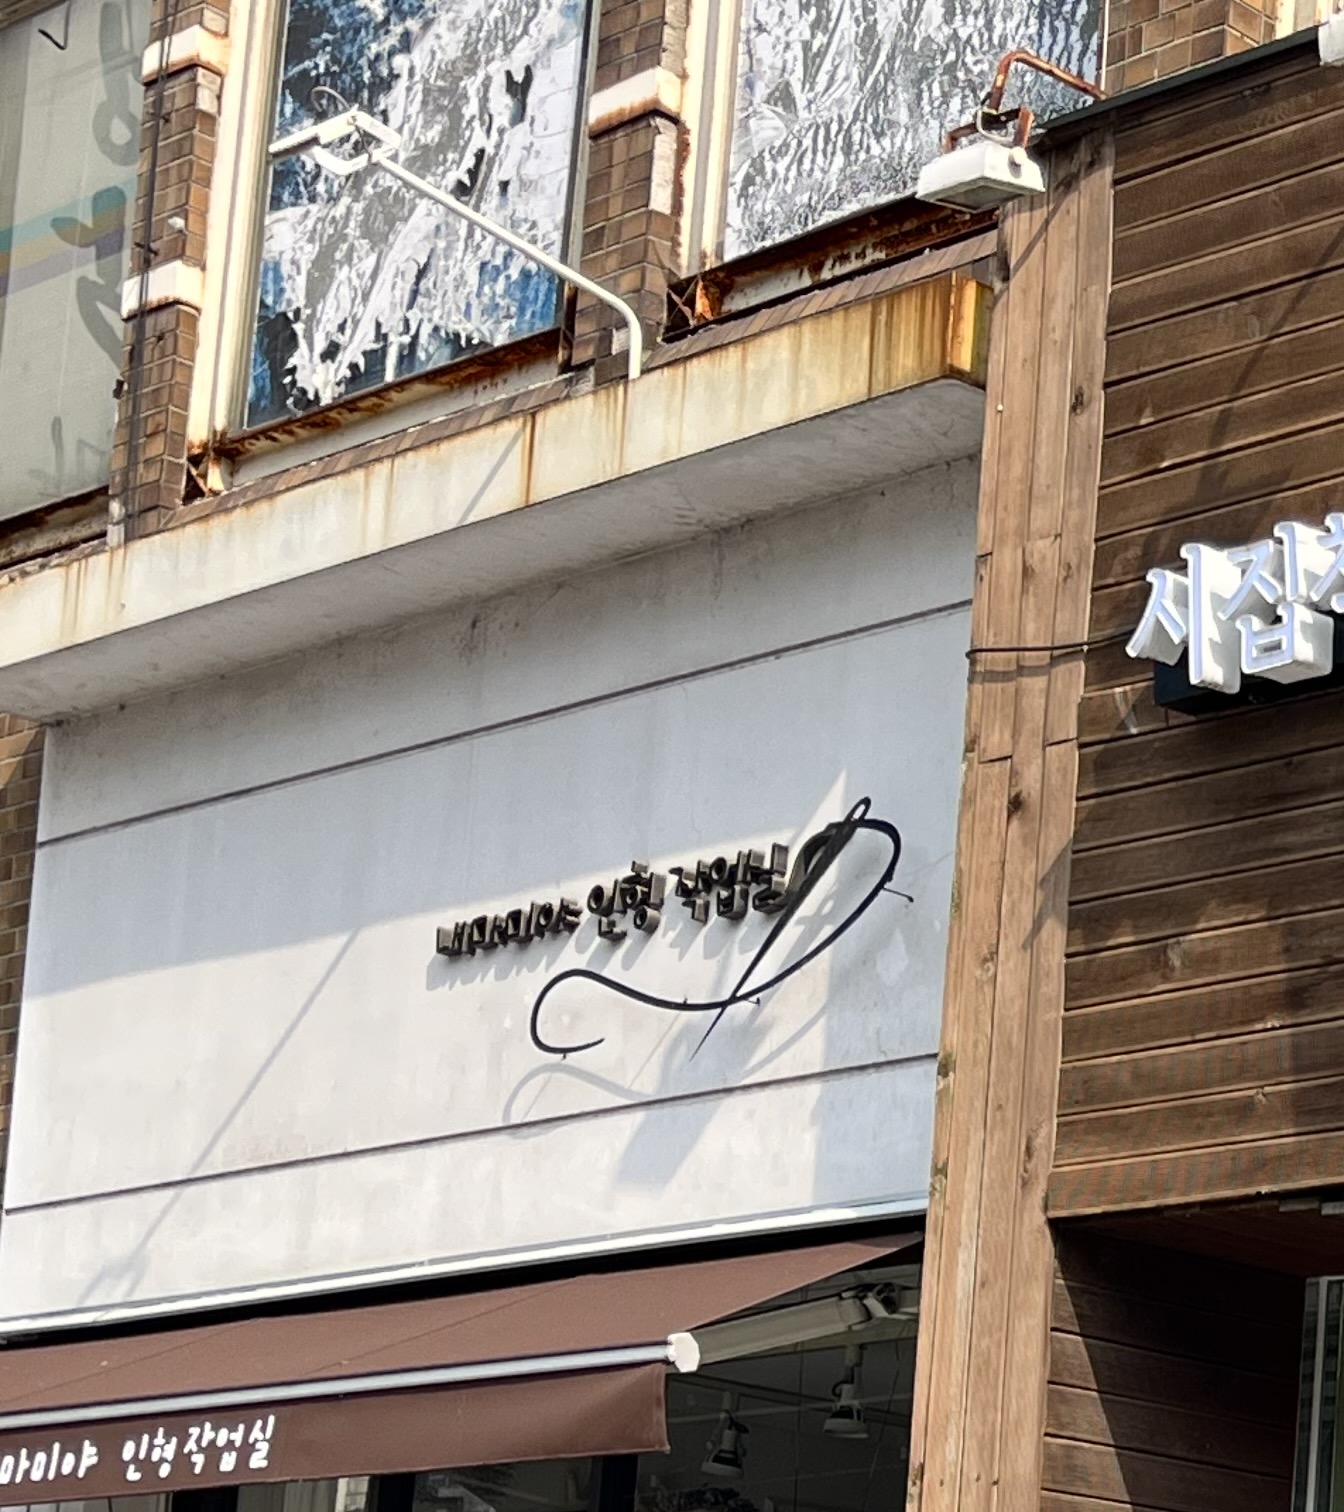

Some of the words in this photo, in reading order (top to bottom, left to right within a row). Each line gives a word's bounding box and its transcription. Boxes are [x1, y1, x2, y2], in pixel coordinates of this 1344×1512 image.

[587, 860, 667, 941] 인형
[122, 1426, 177, 1482] 인형
[183, 1414, 275, 1475] 작업실
